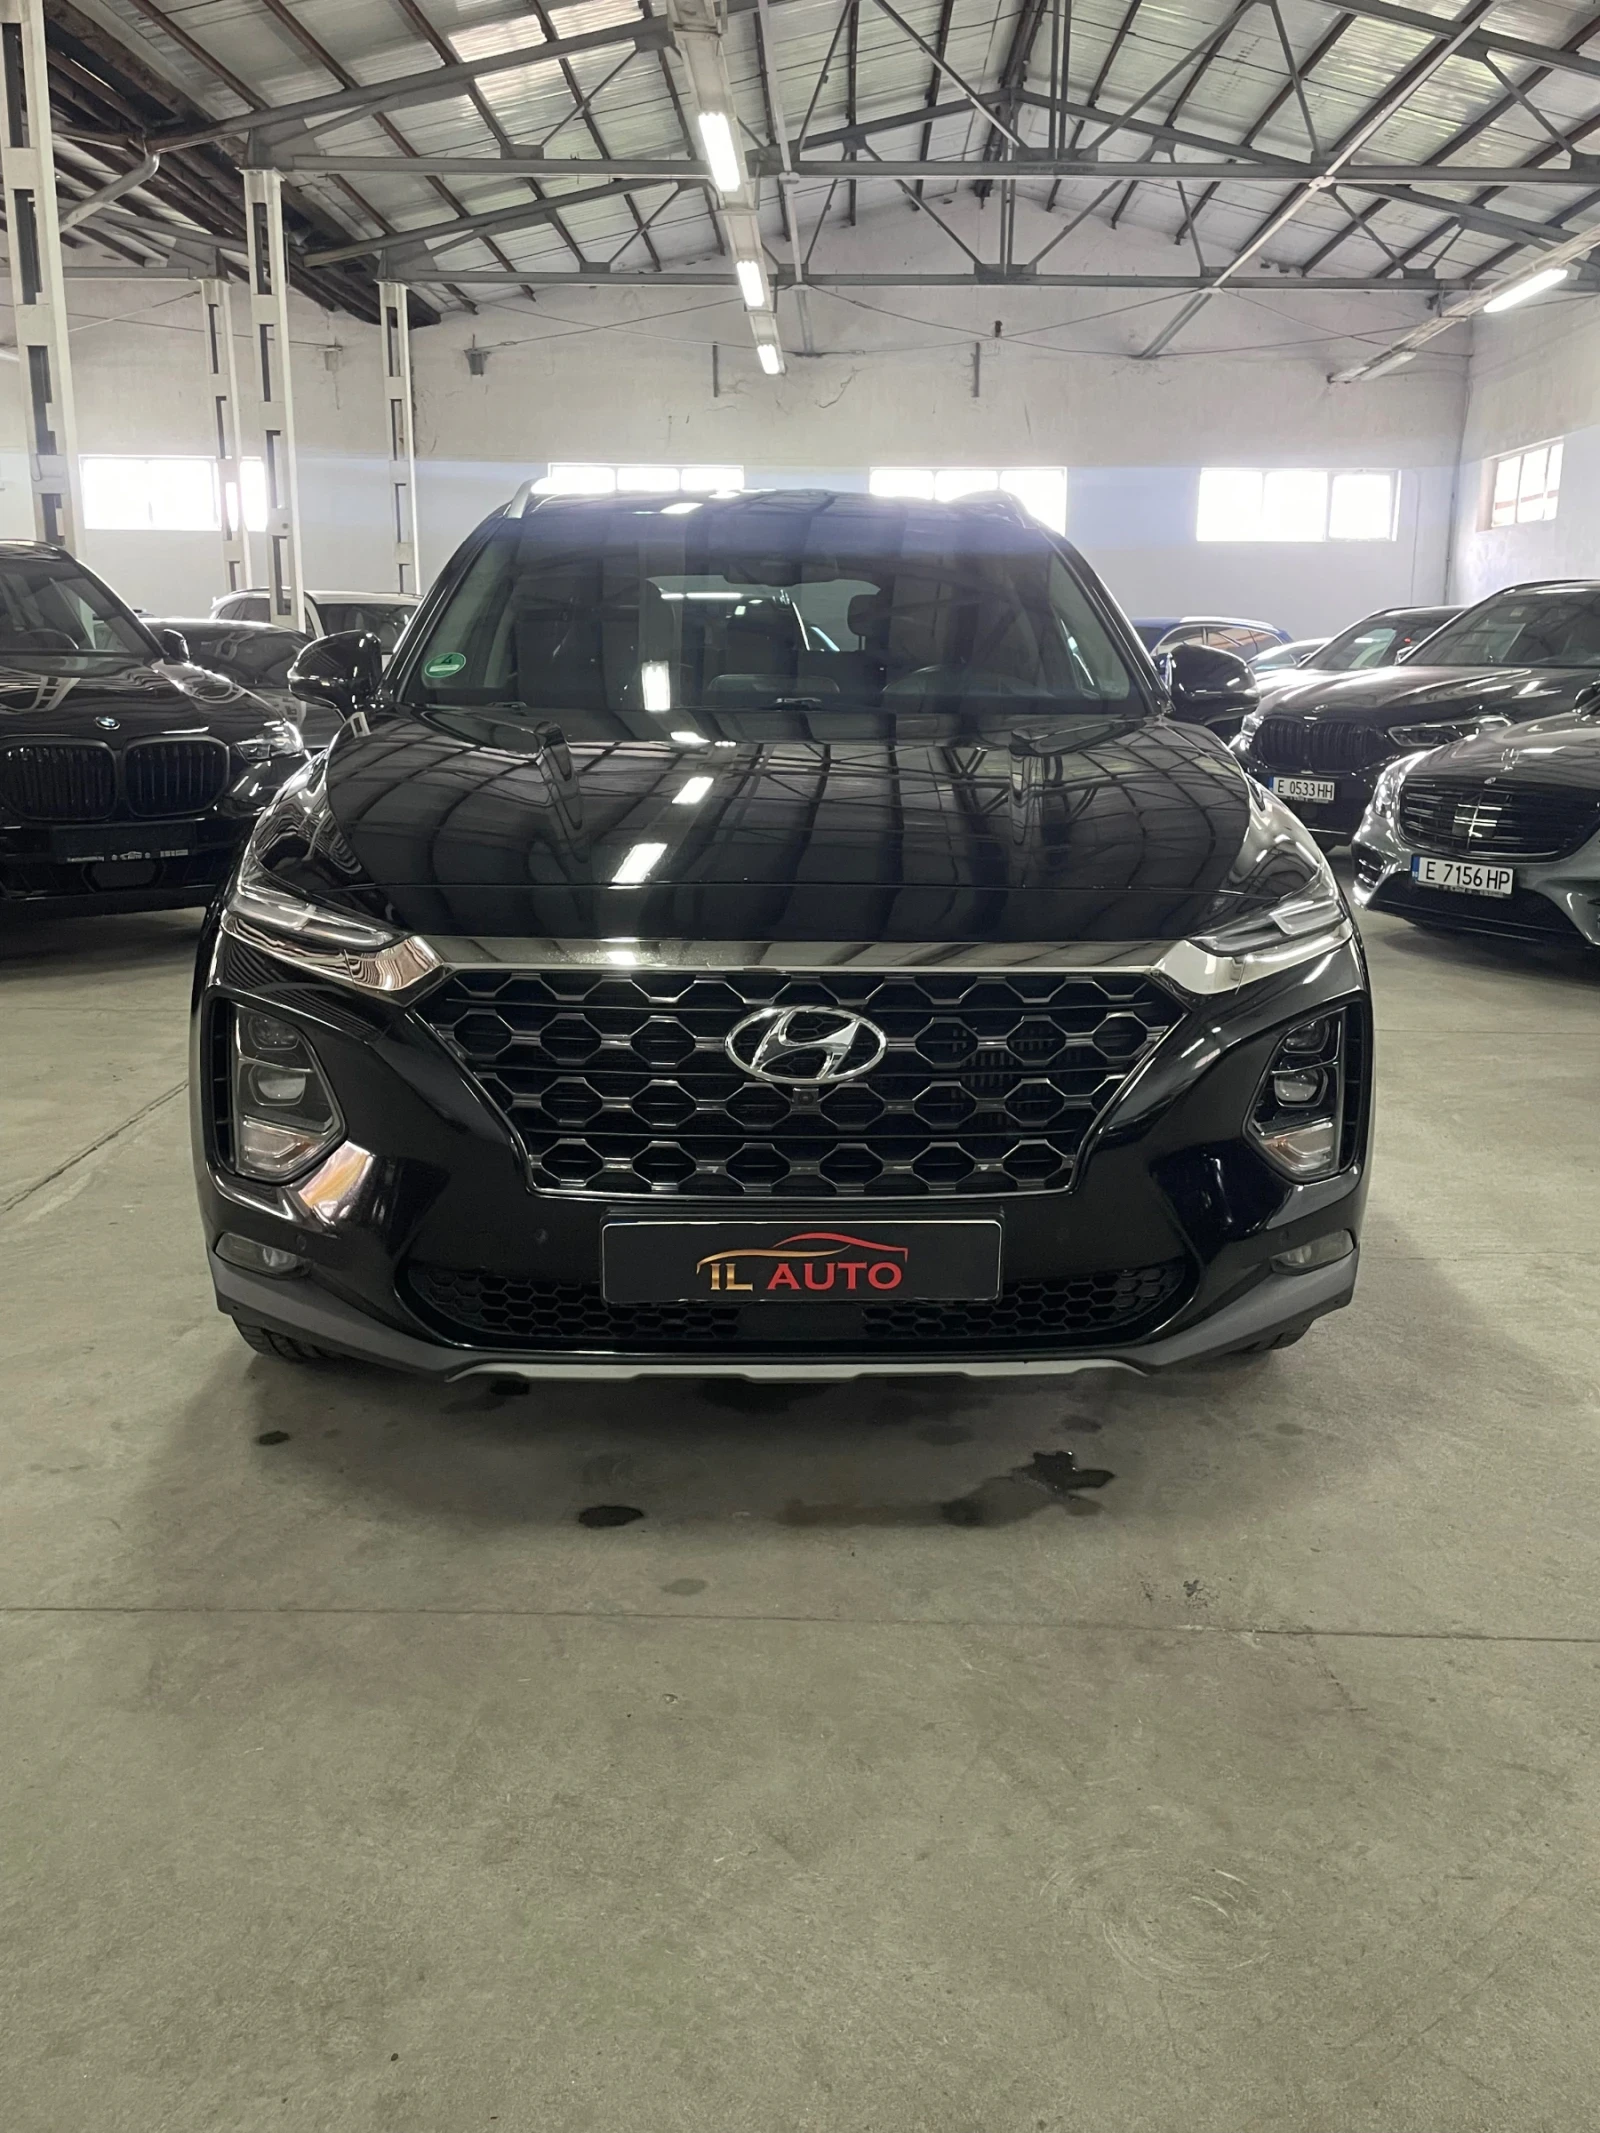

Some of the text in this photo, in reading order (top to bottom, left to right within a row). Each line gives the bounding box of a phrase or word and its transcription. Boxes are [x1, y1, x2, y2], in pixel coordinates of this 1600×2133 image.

[440, 654, 453, 665] 4
[1277, 779, 1333, 799] E 0533 HH
[1425, 861, 1511, 890] E 7156 HP
[710, 1262, 902, 1291] IL AUTO
